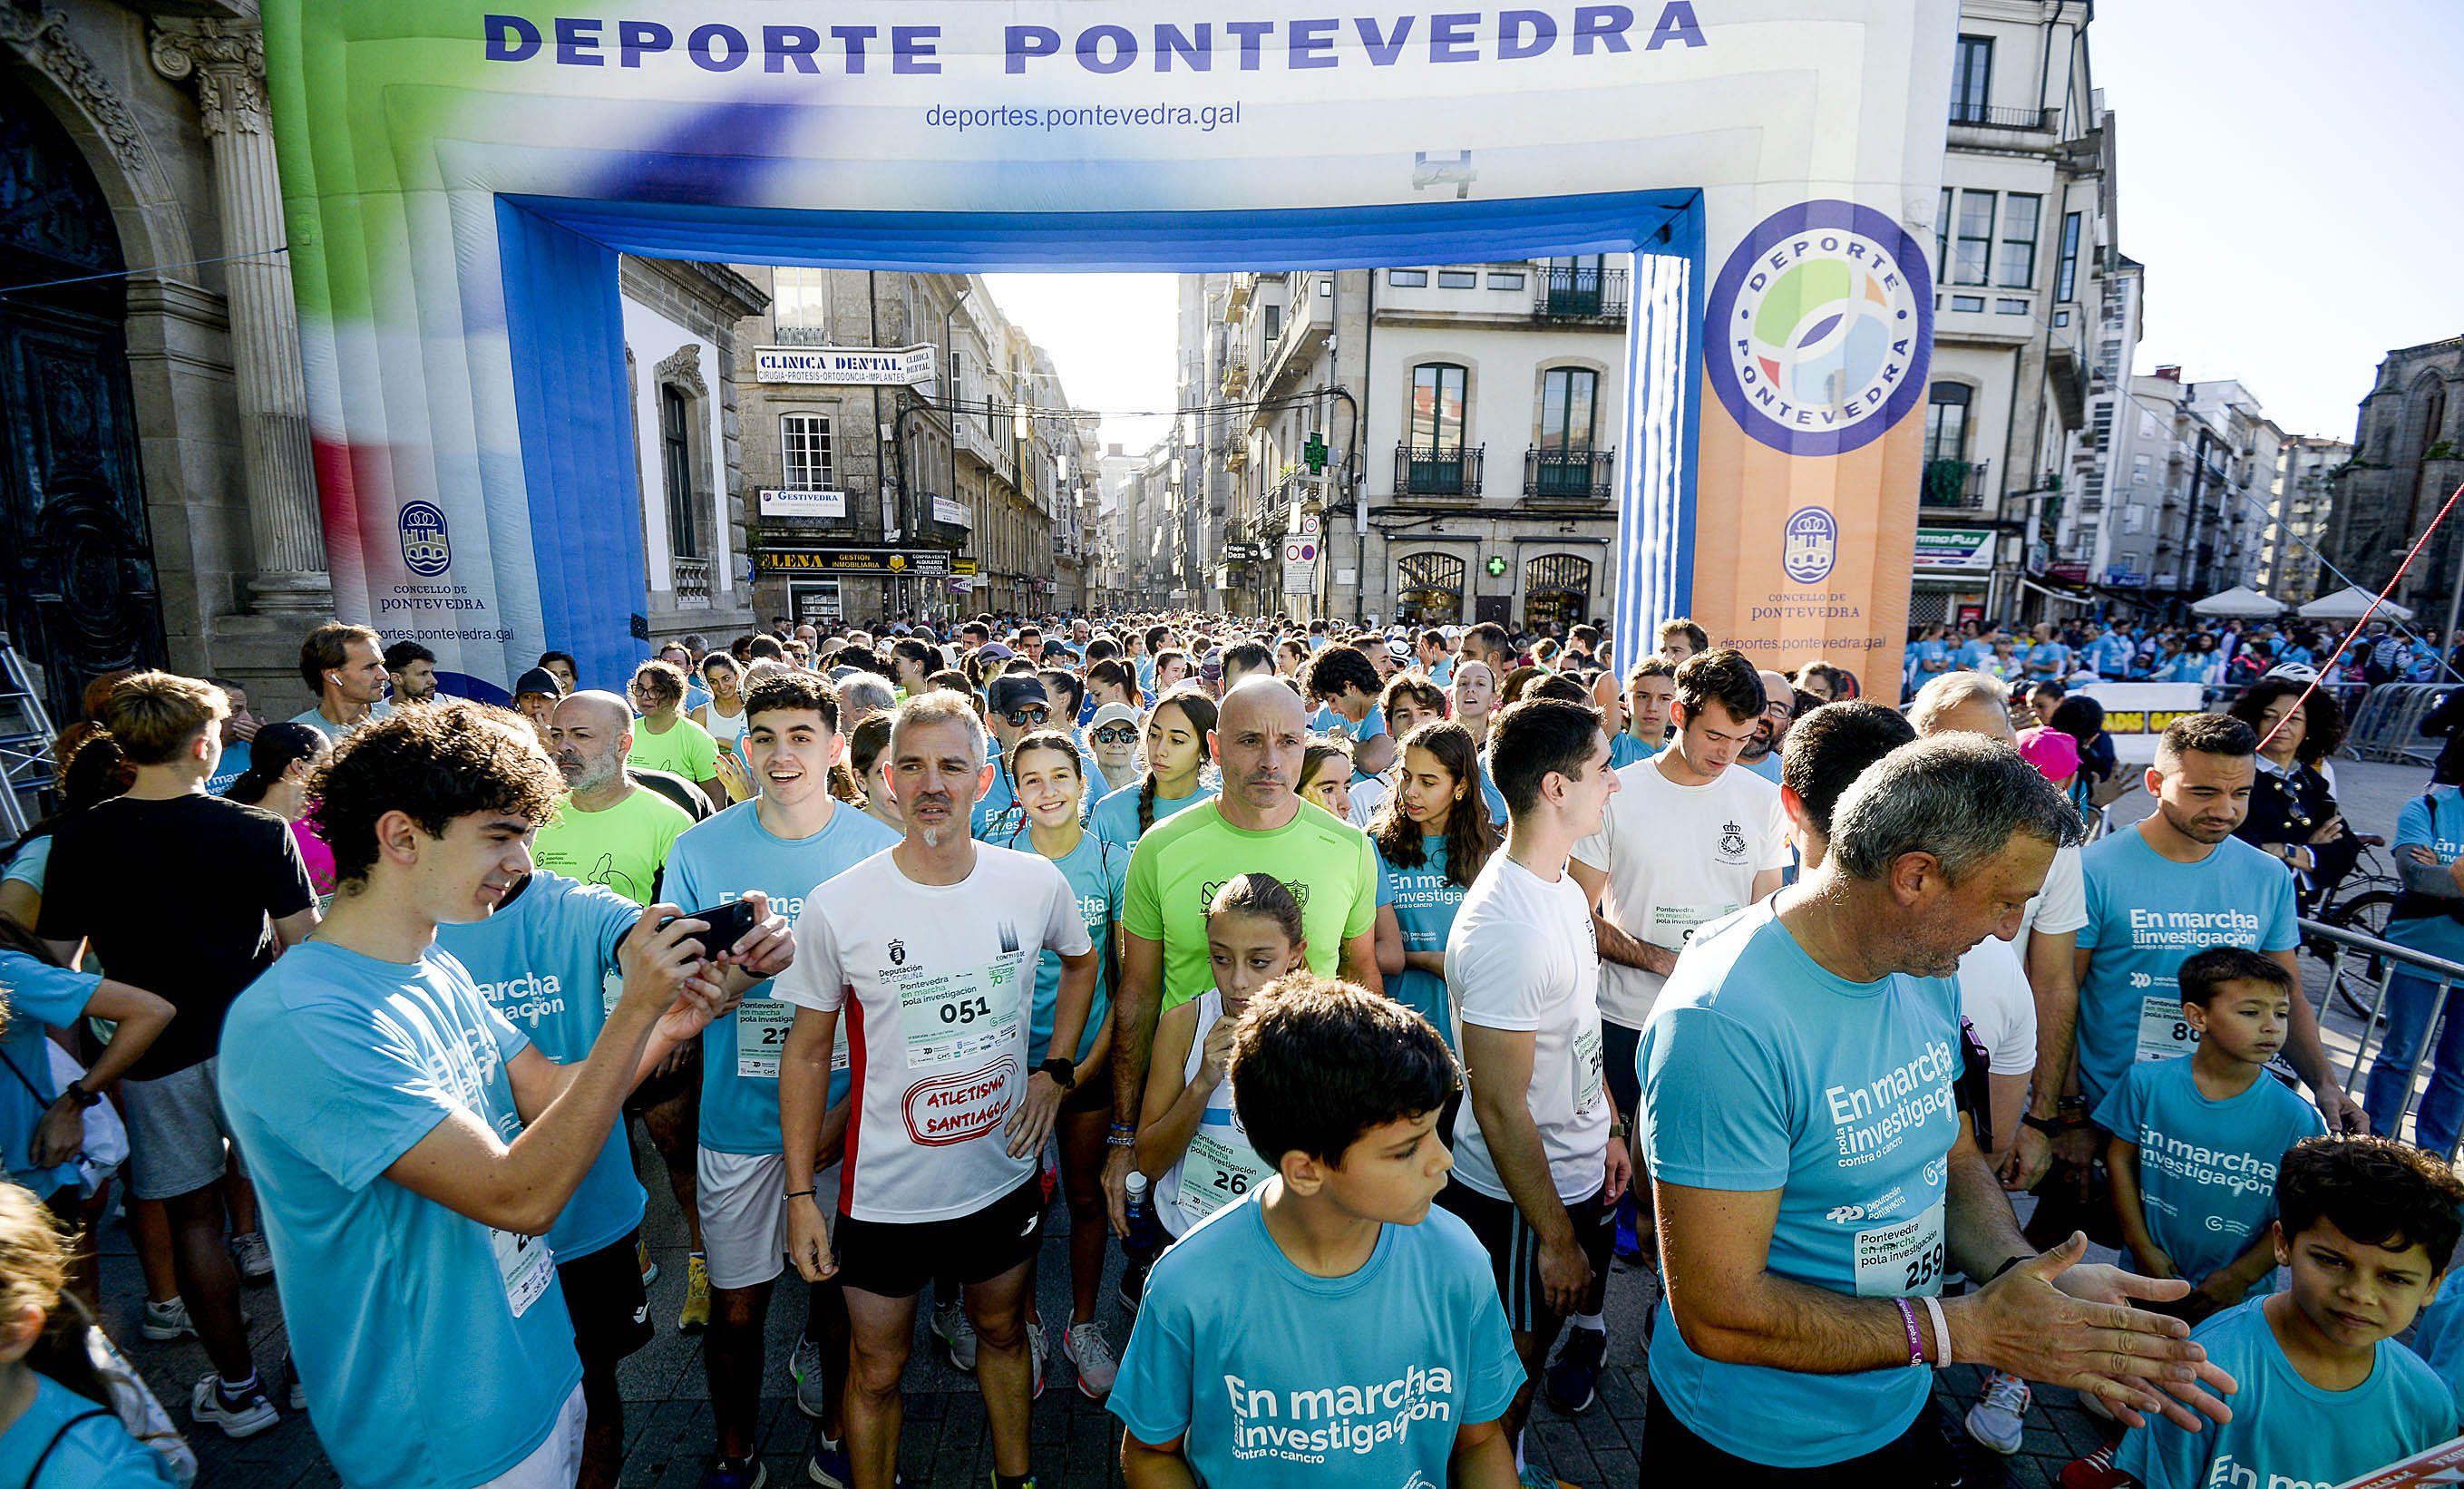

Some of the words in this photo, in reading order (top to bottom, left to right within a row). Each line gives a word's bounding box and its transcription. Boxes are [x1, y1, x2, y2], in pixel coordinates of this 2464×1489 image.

[483, 14, 942, 74] DEPORTE
[1004, 0, 1709, 74] PONTEVEDRA
[926, 101, 1242, 131] deportes.pontevedra.gal
[1748, 237, 1900, 293] DEPORTE
[760, 355, 826, 369] CLINICA
[835, 356, 902, 371] DENTAL
[1738, 338, 1909, 425] PONTEVEDRA
[761, 553, 824, 568] ELENA
[394, 585, 452, 595] CONCELLO
[454, 586, 468, 595] DE
[1768, 593, 1826, 602] CONCELLO
[1829, 593, 1846, 602] DE
[381, 599, 486, 613] PONTEVEDRA
[1751, 607, 1860, 622] PONTEVEDRA
[375, 628, 514, 643] ortes.pontevedra.gal
[1720, 636, 1886, 652] deportes.pontevedra.gal
[1655, 905, 1695, 913] Pontevedra
[2129, 909, 2164, 929] En
[2168, 909, 2259, 929] marcha
[2140, 929, 2255, 948] investigación
[879, 964, 923, 978] Deputación
[476, 971, 561, 1002] archa
[900, 976, 950, 991] Pontevedra
[901, 990, 913, 998] en
[914, 985, 947, 997] marcha
[740, 1001, 784, 1009] Pontevedra
[902, 998, 922, 1007] pola
[923, 986, 978, 1004] investigación
[758, 1016, 794, 1024] investiga
[940, 996, 991, 1024] 051
[927, 1074, 1005, 1108] ATLETISMO
[1826, 1085, 1872, 1125] En
[1871, 1041, 1954, 1110] marcha
[927, 1101, 1000, 1134] SANTIAGO
[1192, 1138, 1202, 1146] en
[1203, 1143, 1229, 1160] marcha
[1193, 1131, 1234, 1154] Pontevedra
[1836, 1127, 1850, 1155] pola
[1837, 1153, 1875, 1168] contra
[1875, 1149, 1882, 1158] o
[1882, 1135, 1903, 1156] cancro
[1191, 1145, 1207, 1158] pola
[1207, 1153, 1257, 1175] investigación
[2167, 1136, 2278, 1182] marcha
[1213, 1170, 1248, 1195] 26
[2142, 1147, 2274, 1197] nvestigación
[1866, 1185, 1902, 1212] Deputación
[1867, 1195, 1905, 1221] Pontevedra
[1860, 1222, 1919, 1244] Pontevedra
[1860, 1246, 1876, 1255] en
[1879, 1235, 1915, 1252] marcha
[1861, 1254, 1887, 1268] pola
[1890, 1229, 1937, 1261] investigación
[1904, 1242, 1943, 1291] 259
[1224, 1374, 1278, 1418] En
[1290, 1364, 1452, 1420] marcha
[1239, 1396, 1450, 1454] investigación
[1232, 1445, 1267, 1460] contra
[1269, 1448, 1279, 1456] o
[1280, 1450, 1325, 1464] cancro
